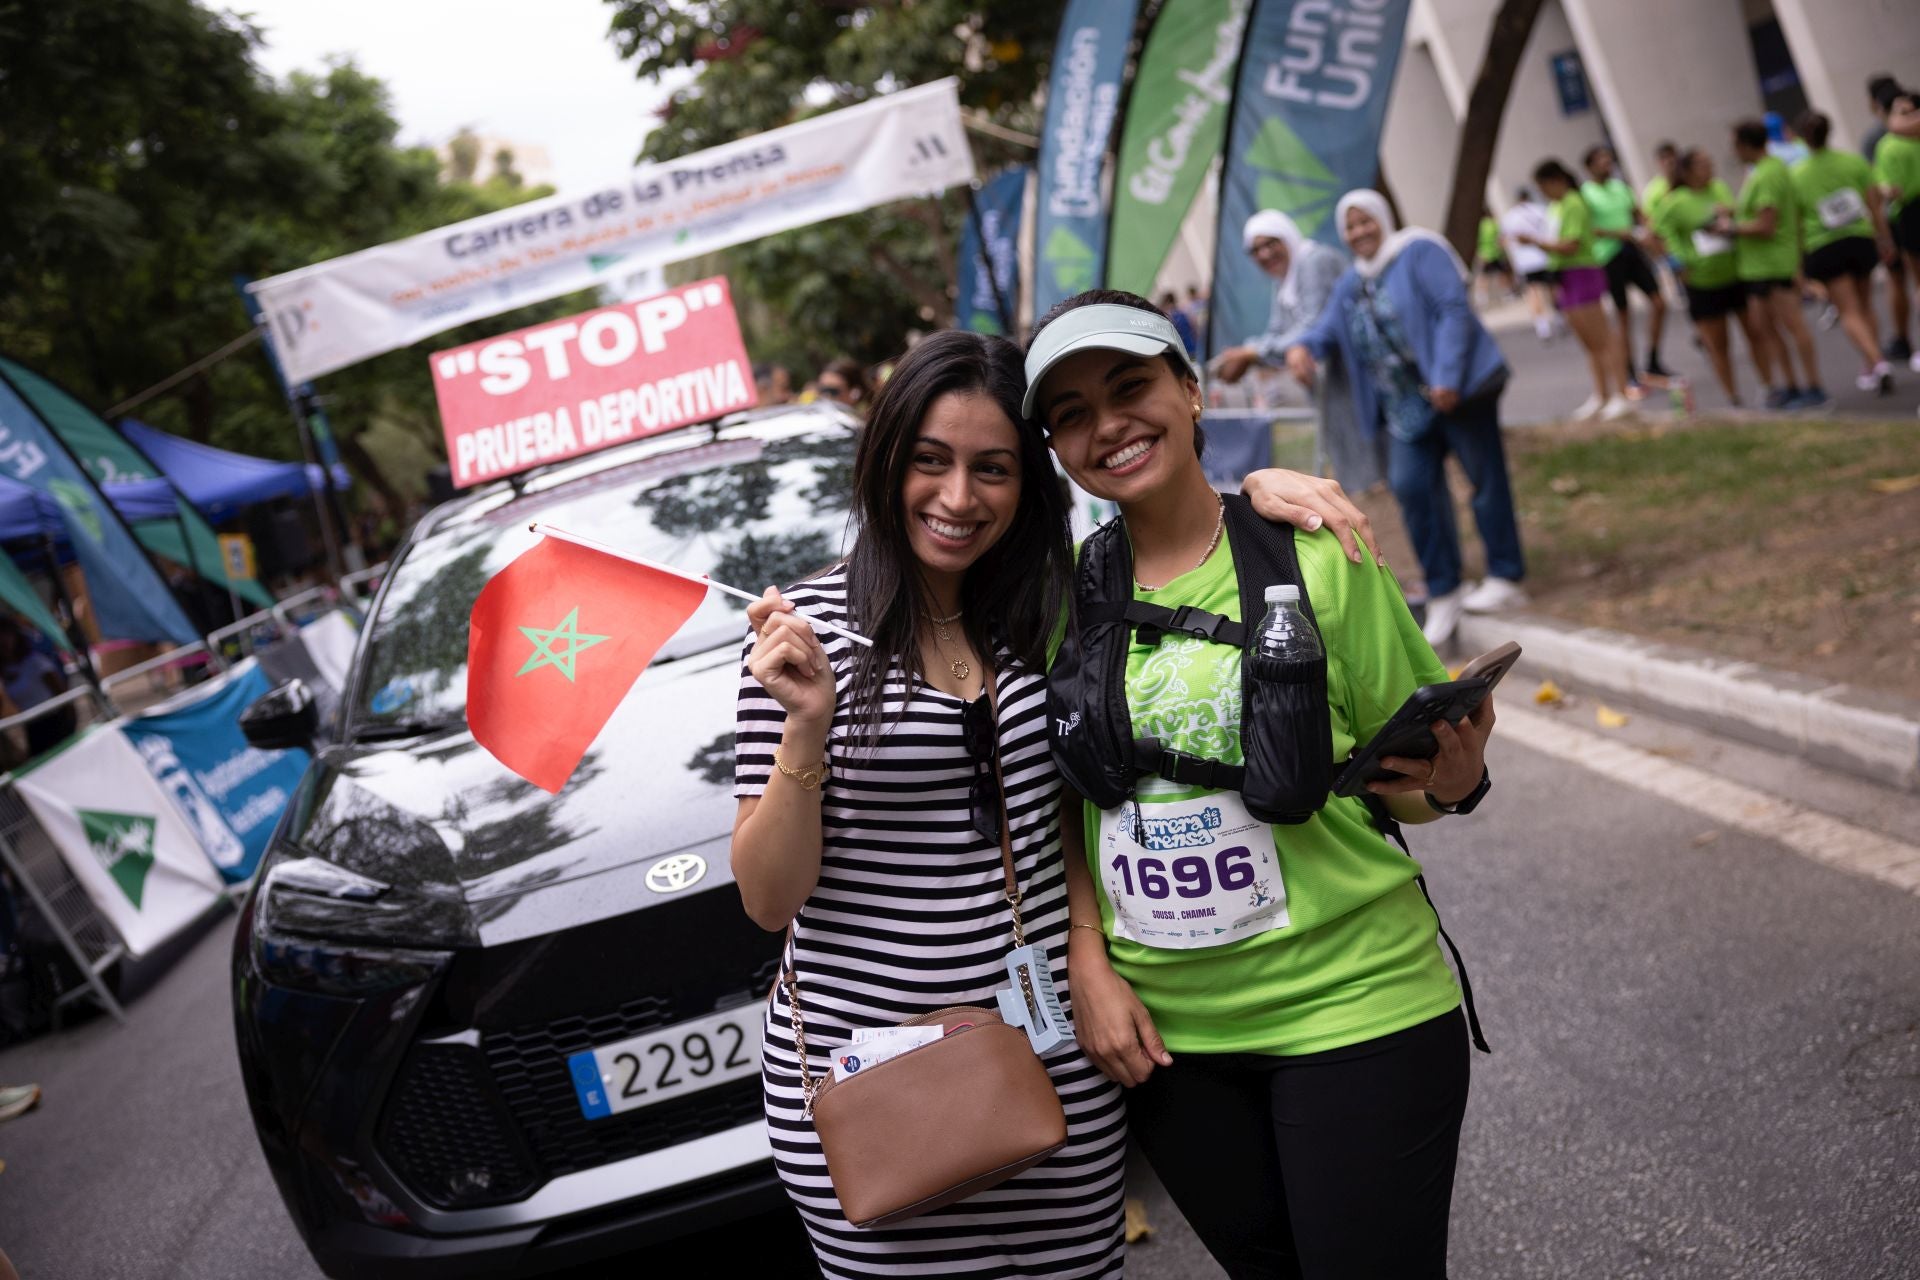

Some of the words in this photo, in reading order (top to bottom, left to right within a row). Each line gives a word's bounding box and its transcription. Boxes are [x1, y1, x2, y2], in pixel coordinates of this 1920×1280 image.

[1263, 0, 1330, 104] Fun
[445, 206, 574, 259] Carrera
[582, 189, 624, 219] de
[633, 176, 663, 202] la
[672, 144, 788, 190] Prensa
[438, 283, 723, 396] "STOP"
[456, 407, 578, 481] PRUEBA
[580, 360, 749, 447] DEPORTIVA
[1112, 846, 1255, 900] 1696
[1152, 909, 1175, 920] SOUSSI
[1181, 907, 1217, 920] CHAIMAE
[613, 1022, 751, 1100] 2292
